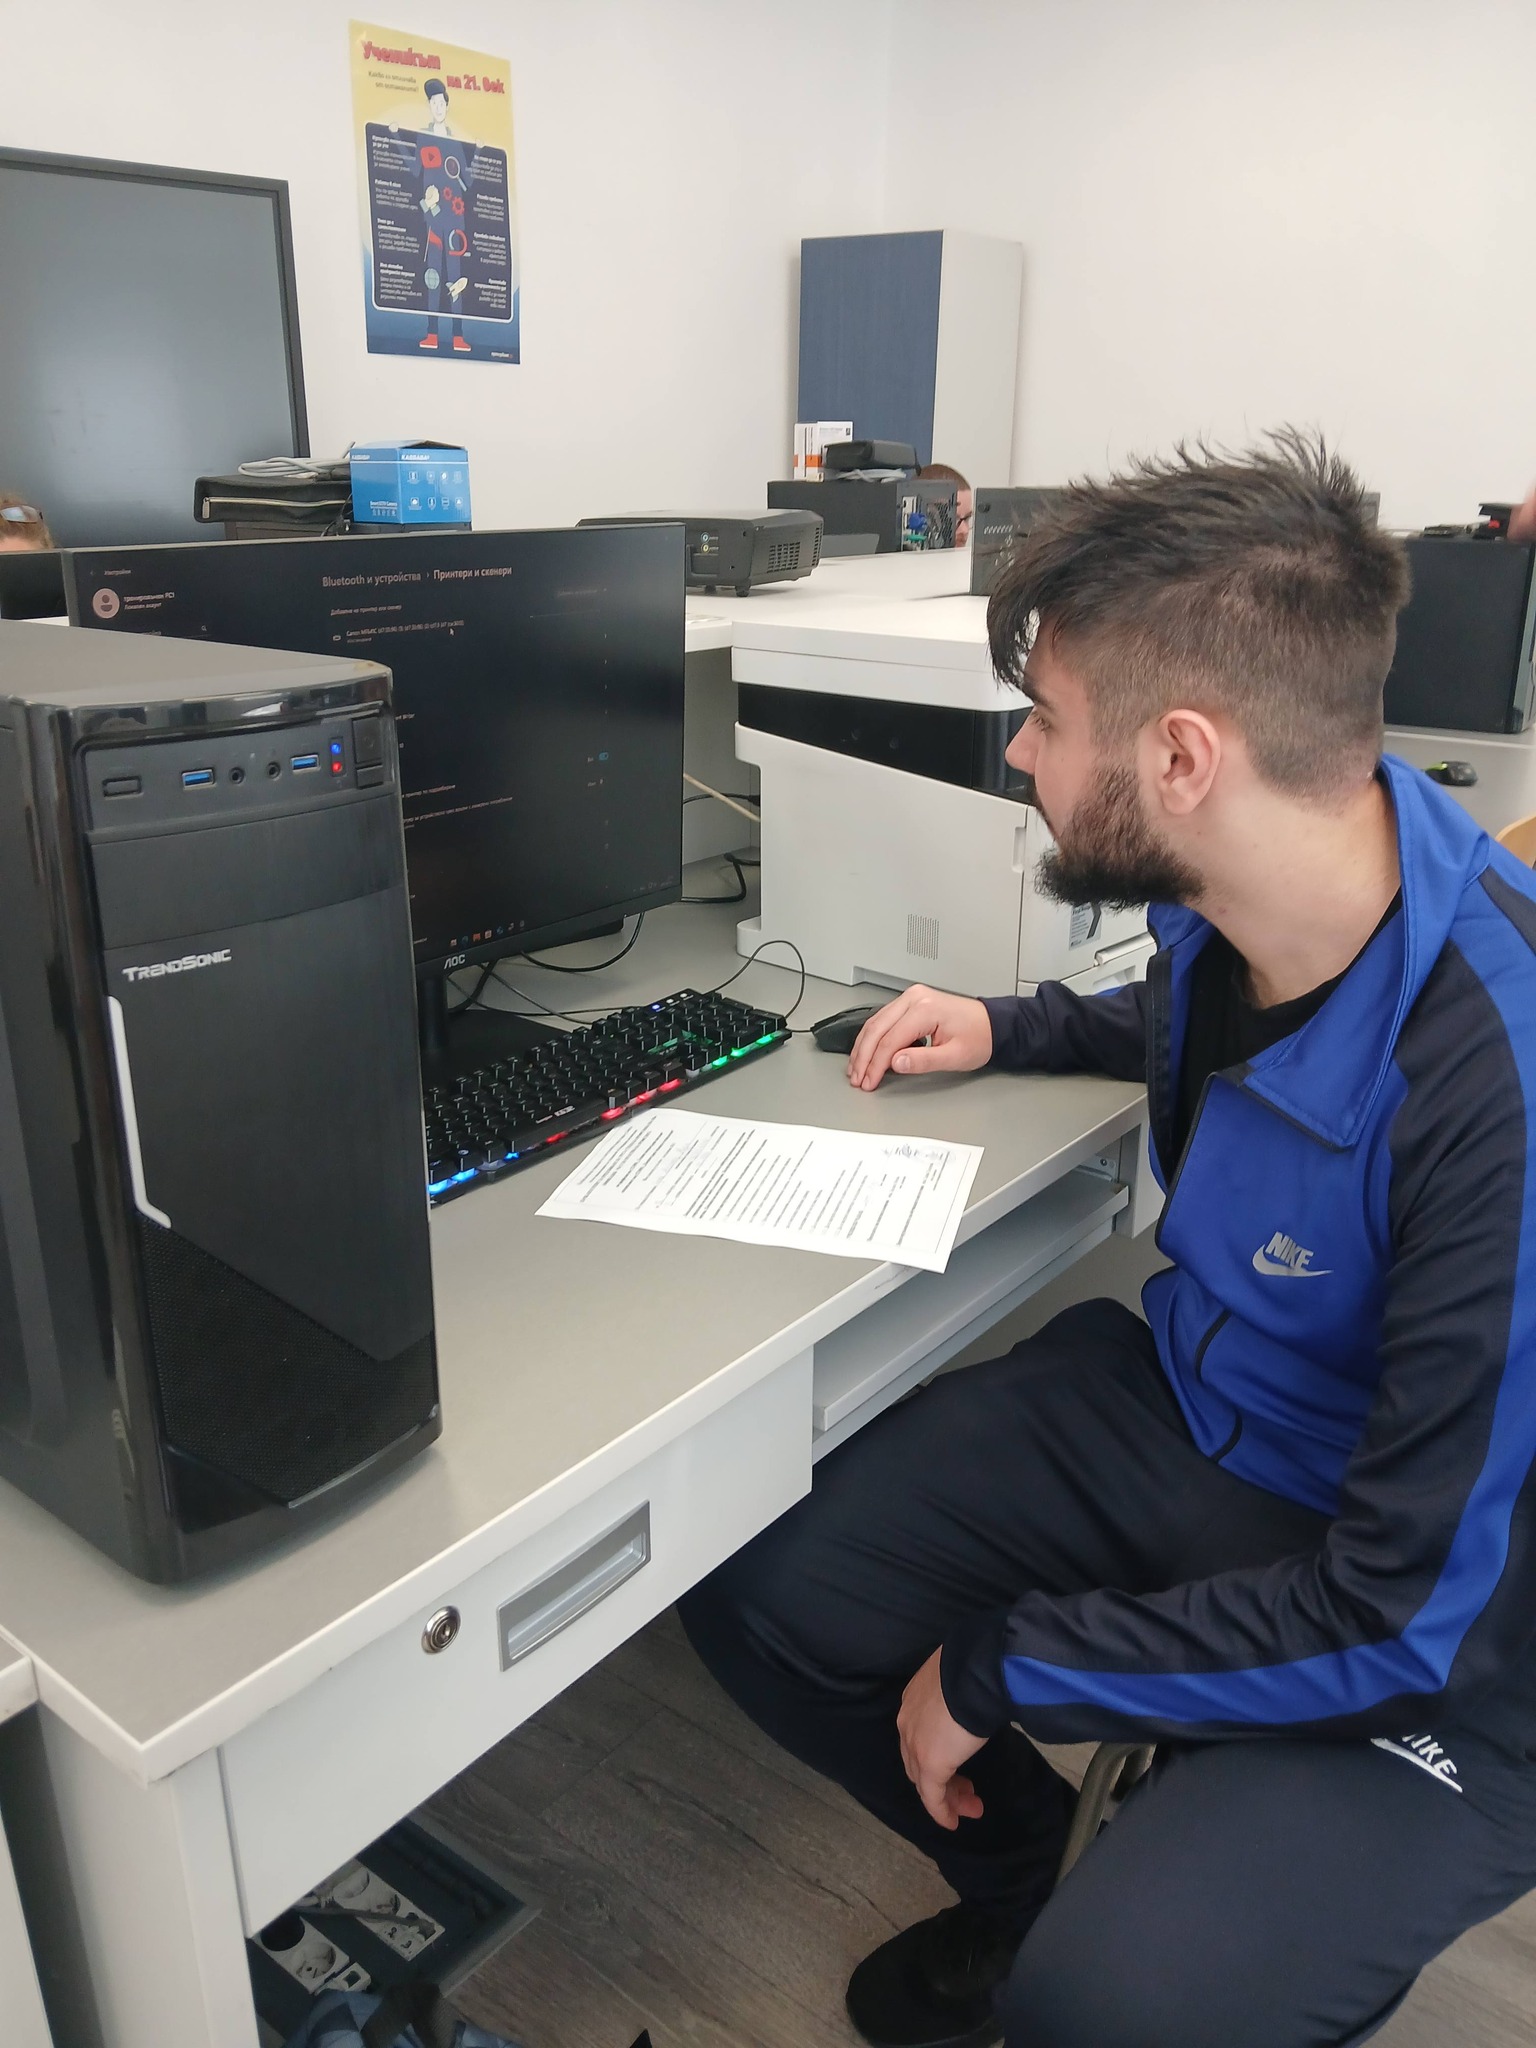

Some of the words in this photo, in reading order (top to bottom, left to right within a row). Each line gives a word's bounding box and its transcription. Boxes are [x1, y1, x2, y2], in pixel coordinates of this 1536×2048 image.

[446, 75, 462, 89] на
[322, 574, 366, 588] Bluetooth
[366, 576, 373, 584] и
[374, 571, 422, 586] устройства
[433, 569, 473, 582] Принтери
[474, 569, 480, 577] и
[480, 567, 513, 578] скенери
[121, 948, 232, 982] TRENDSONIC
[443, 954, 466, 970] AOC
[1264, 1231, 1314, 1270] NIKE
[1401, 1733, 1458, 1775] IKE
